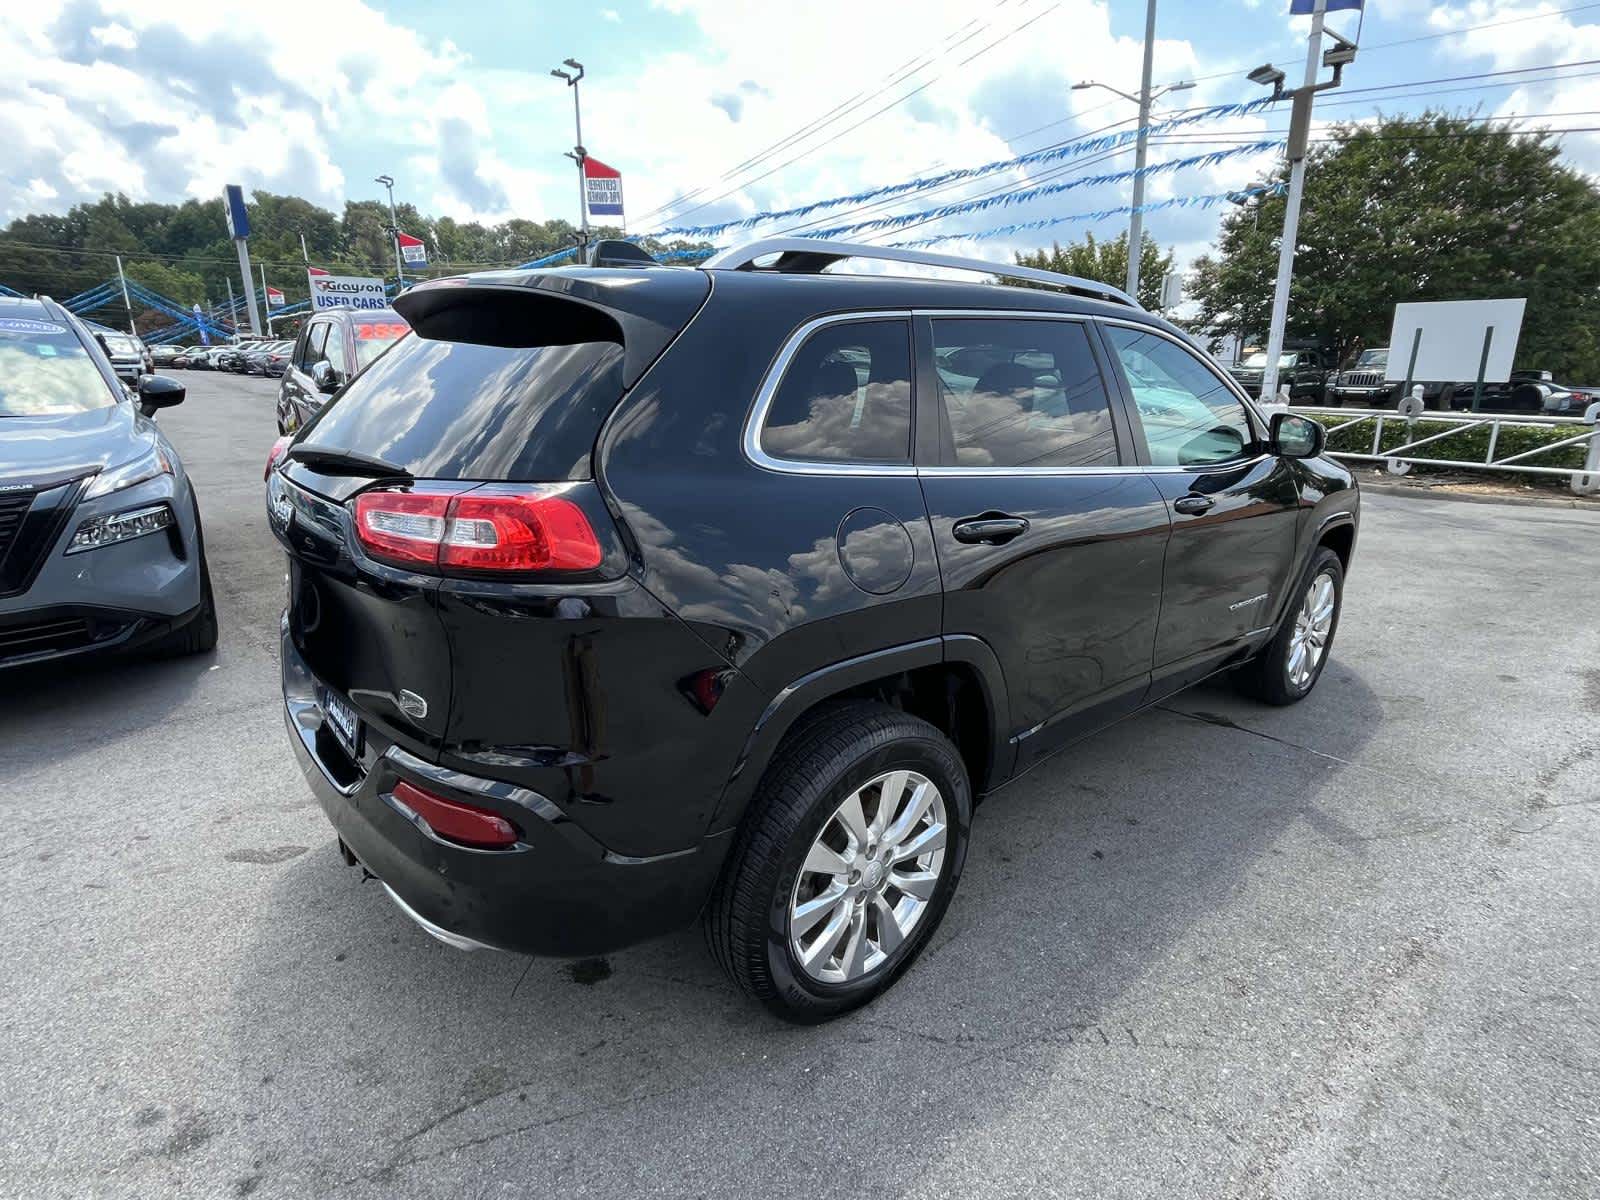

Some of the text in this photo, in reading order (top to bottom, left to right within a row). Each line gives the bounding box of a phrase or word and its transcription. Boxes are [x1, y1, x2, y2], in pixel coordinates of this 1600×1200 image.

[326, 280, 383, 294] Grayson
[317, 295, 385, 309] USED CARS
